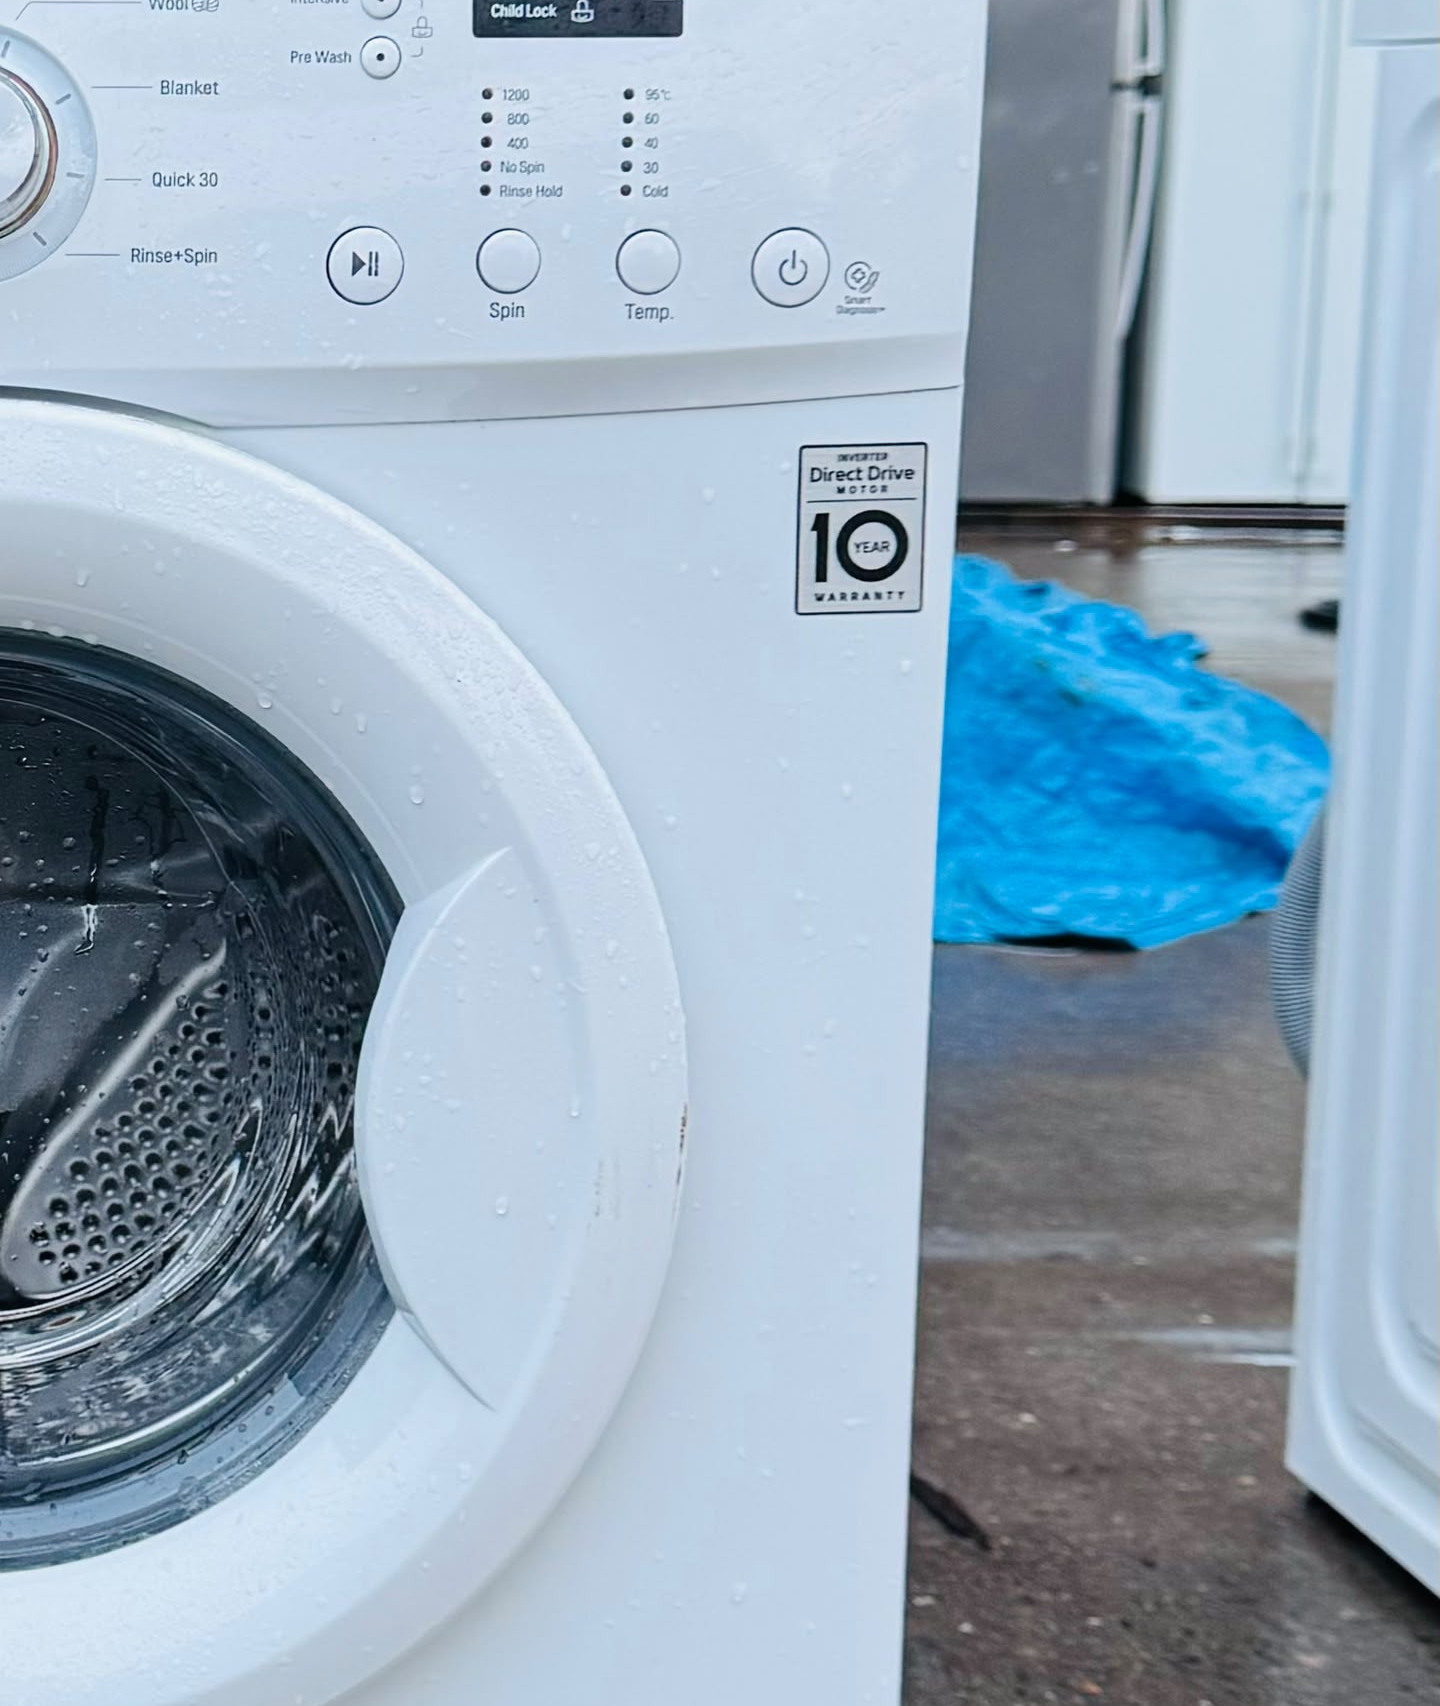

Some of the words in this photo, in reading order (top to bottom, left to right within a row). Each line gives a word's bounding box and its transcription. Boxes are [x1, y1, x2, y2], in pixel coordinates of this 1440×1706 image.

[490, 3, 524, 18] Child
[526, 3, 558, 18] Lock
[290, 50, 312, 63] Pre
[315, 50, 352, 64] Wash
[160, 80, 220, 95] Blanket
[502, 89, 530, 101] 1200
[507, 113, 530, 125] 800
[507, 137, 529, 149] 400
[644, 137, 658, 149] 40
[500, 161, 517, 173] No
[519, 161, 545, 175] Spin
[643, 162, 659, 174] 30
[152, 172, 195, 188] Quick
[198, 172, 219, 187] 30
[500, 185, 532, 197] Rinse
[536, 185, 563, 197] Hold
[642, 185, 669, 197] Cold
[130, 248, 218, 267] Rinse+Spin
[489, 301, 525, 323] Spin
[625, 302, 675, 323] Temp.
[837, 452, 888, 462] INVERTER
[810, 466, 863, 482] Direct
[867, 465, 915, 481] Drive
[836, 485, 888, 494] MOTOR
[810, 509, 908, 582] 10
[854, 541, 891, 553] YEAR
[814, 591, 905, 602] WARRANTY
